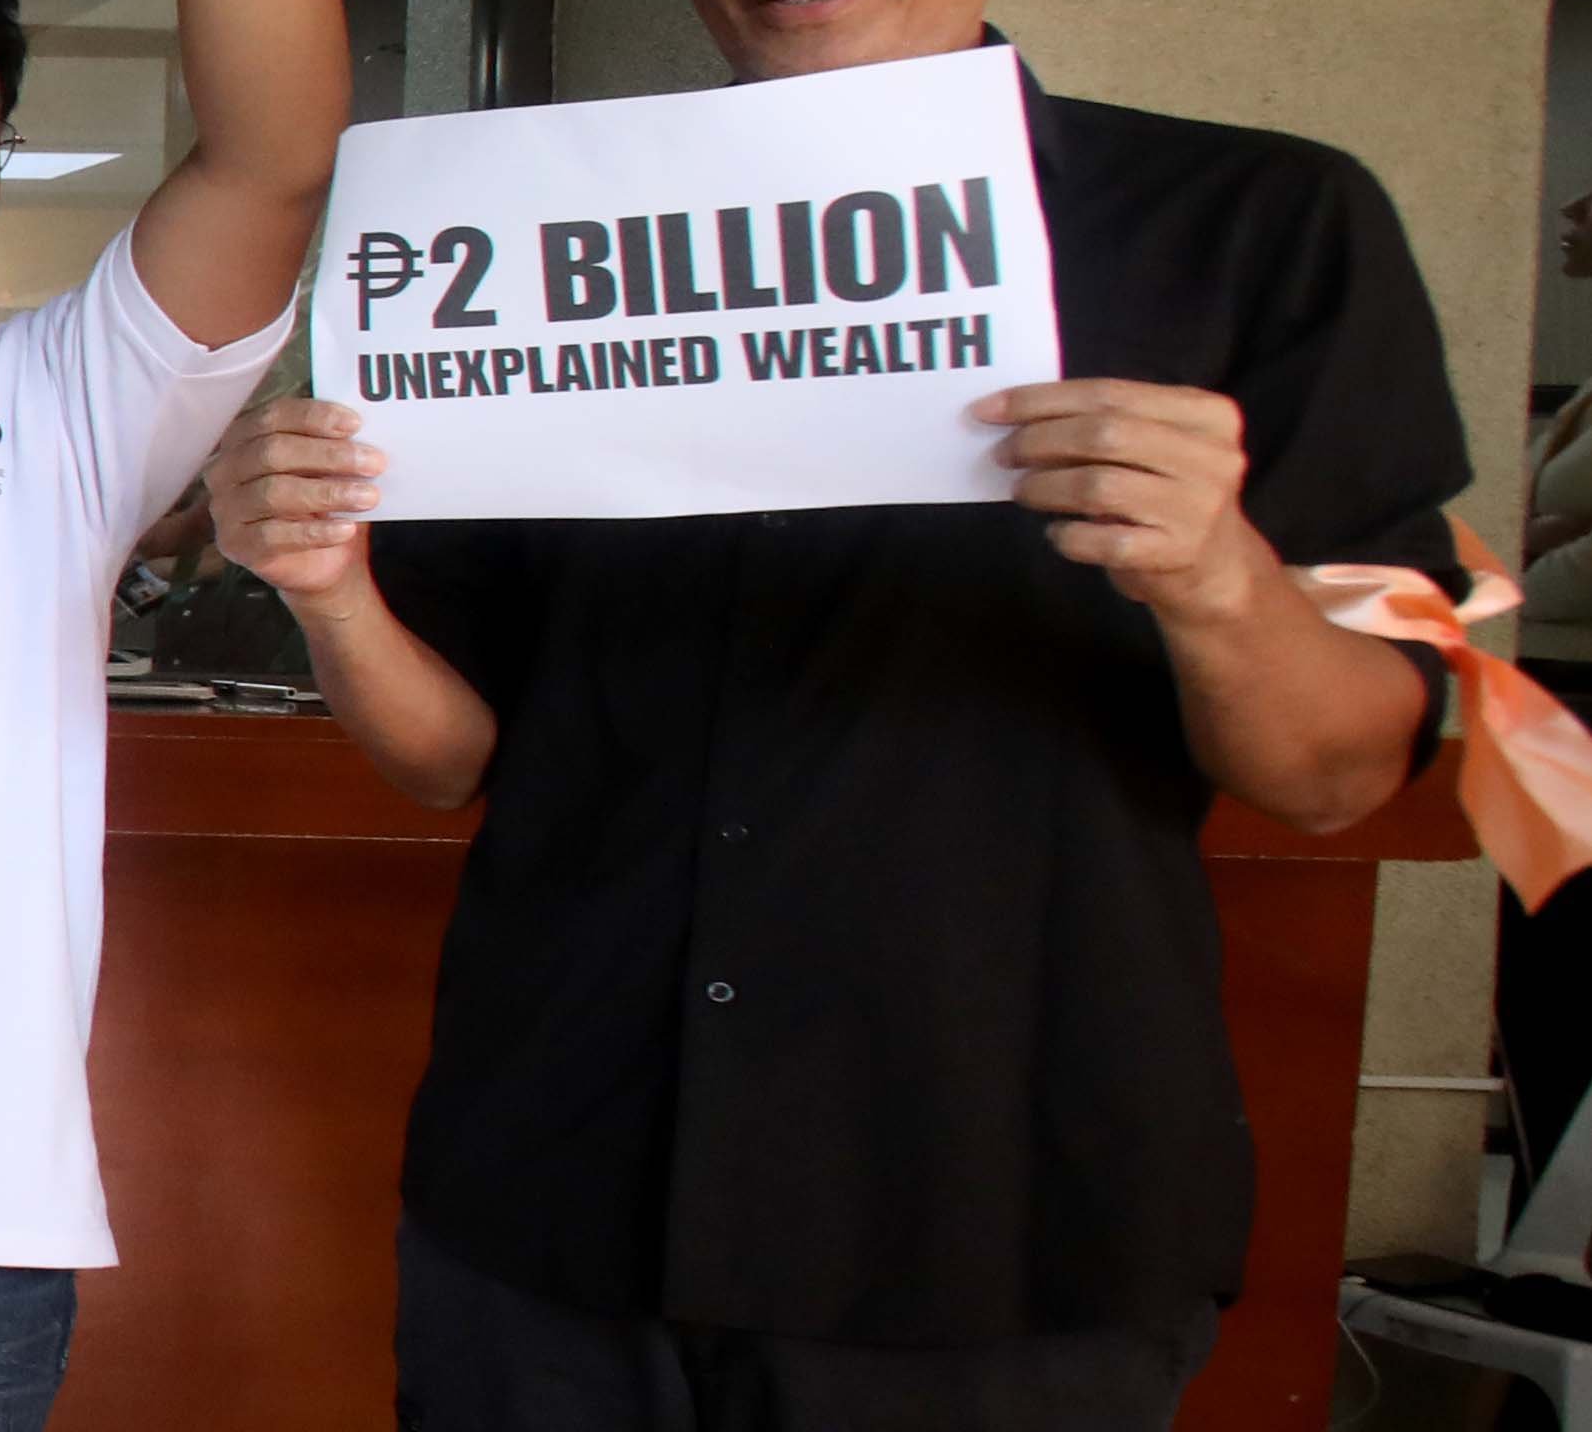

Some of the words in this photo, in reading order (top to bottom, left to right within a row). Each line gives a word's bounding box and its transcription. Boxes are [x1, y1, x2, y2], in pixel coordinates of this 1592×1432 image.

[345, 225, 499, 331] ₱2
[539, 176, 1001, 323] BILLION
[358, 335, 720, 403] UNEXPLAINED
[741, 313, 992, 382] WEALTH
